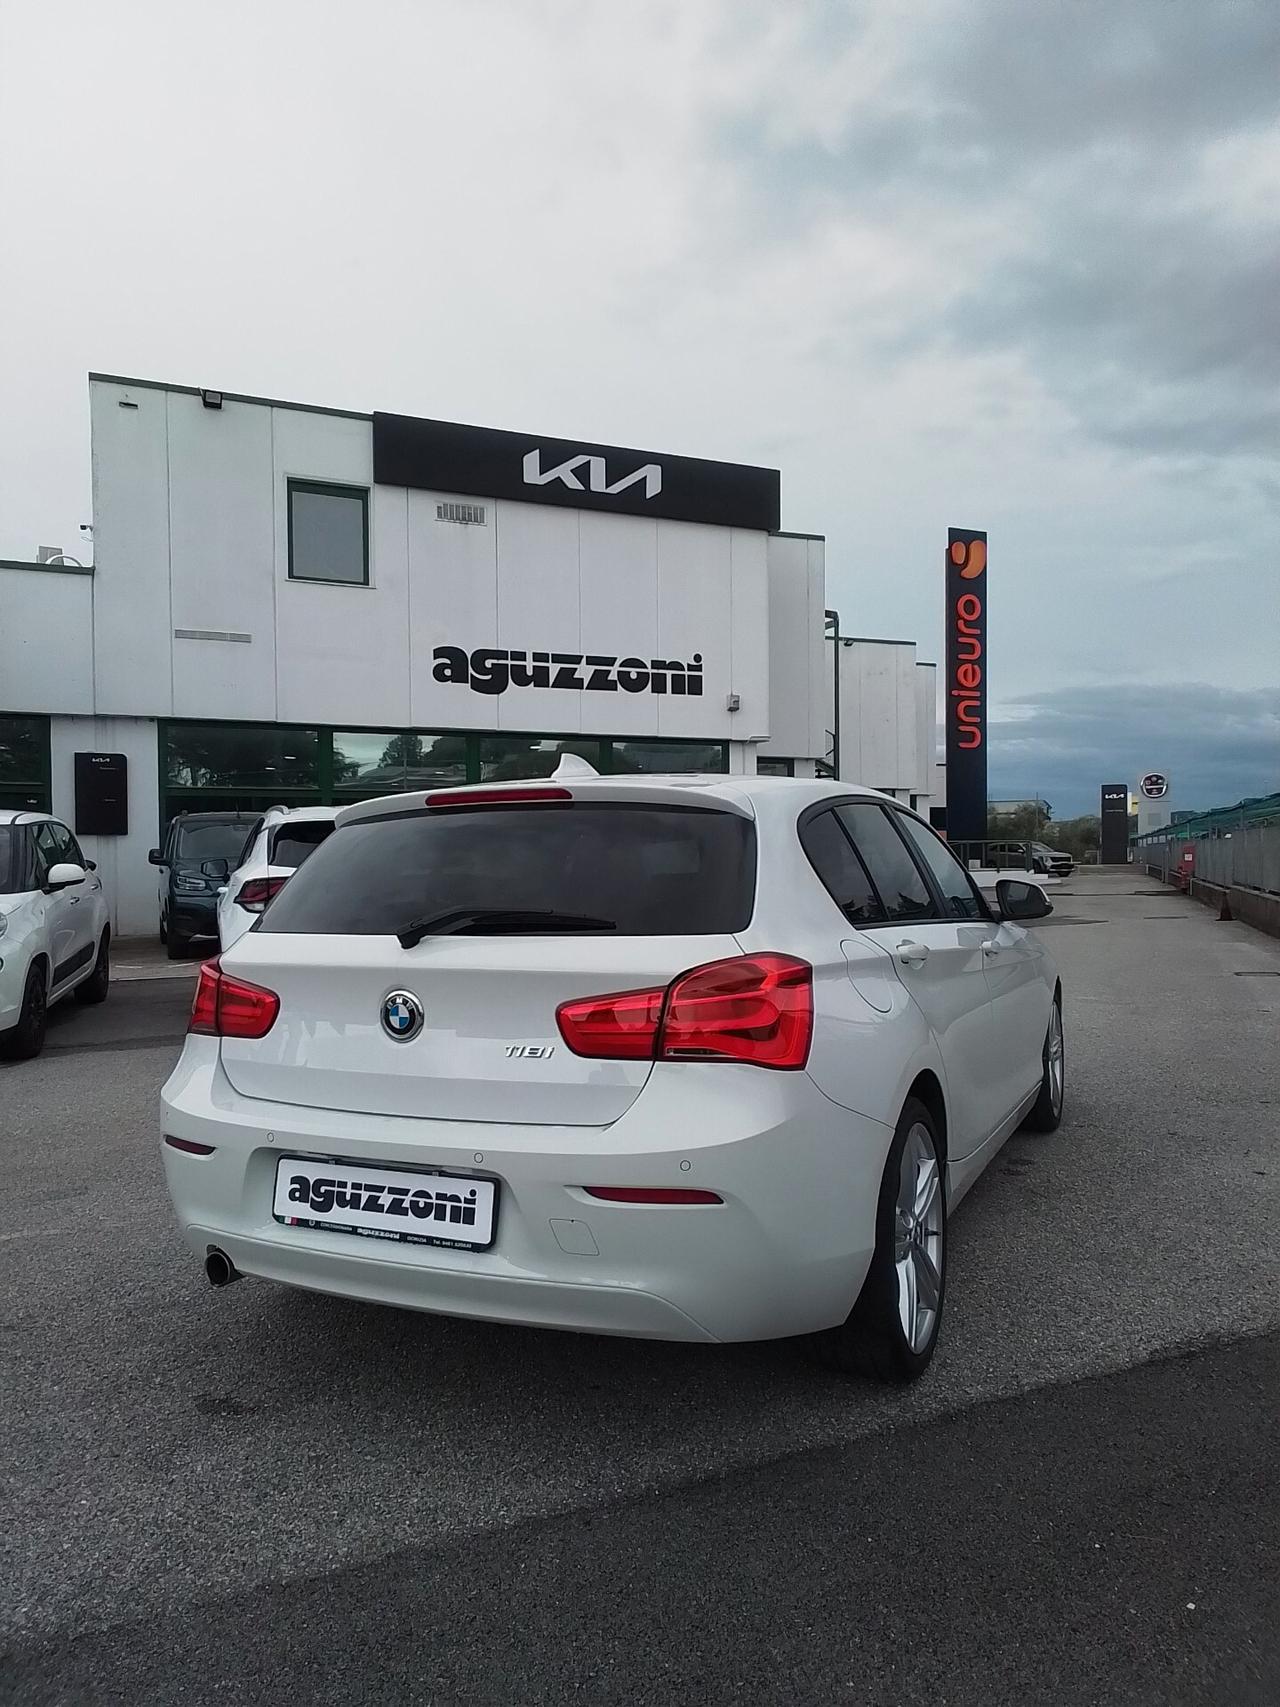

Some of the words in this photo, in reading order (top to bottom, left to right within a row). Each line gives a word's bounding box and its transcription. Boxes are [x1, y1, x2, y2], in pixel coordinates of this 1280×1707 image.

[523, 449, 662, 499] KIA
[432, 646, 703, 696] aguzzoni
[952, 594, 981, 748] unieuro
[288, 1175, 477, 1225] aguzzoni
